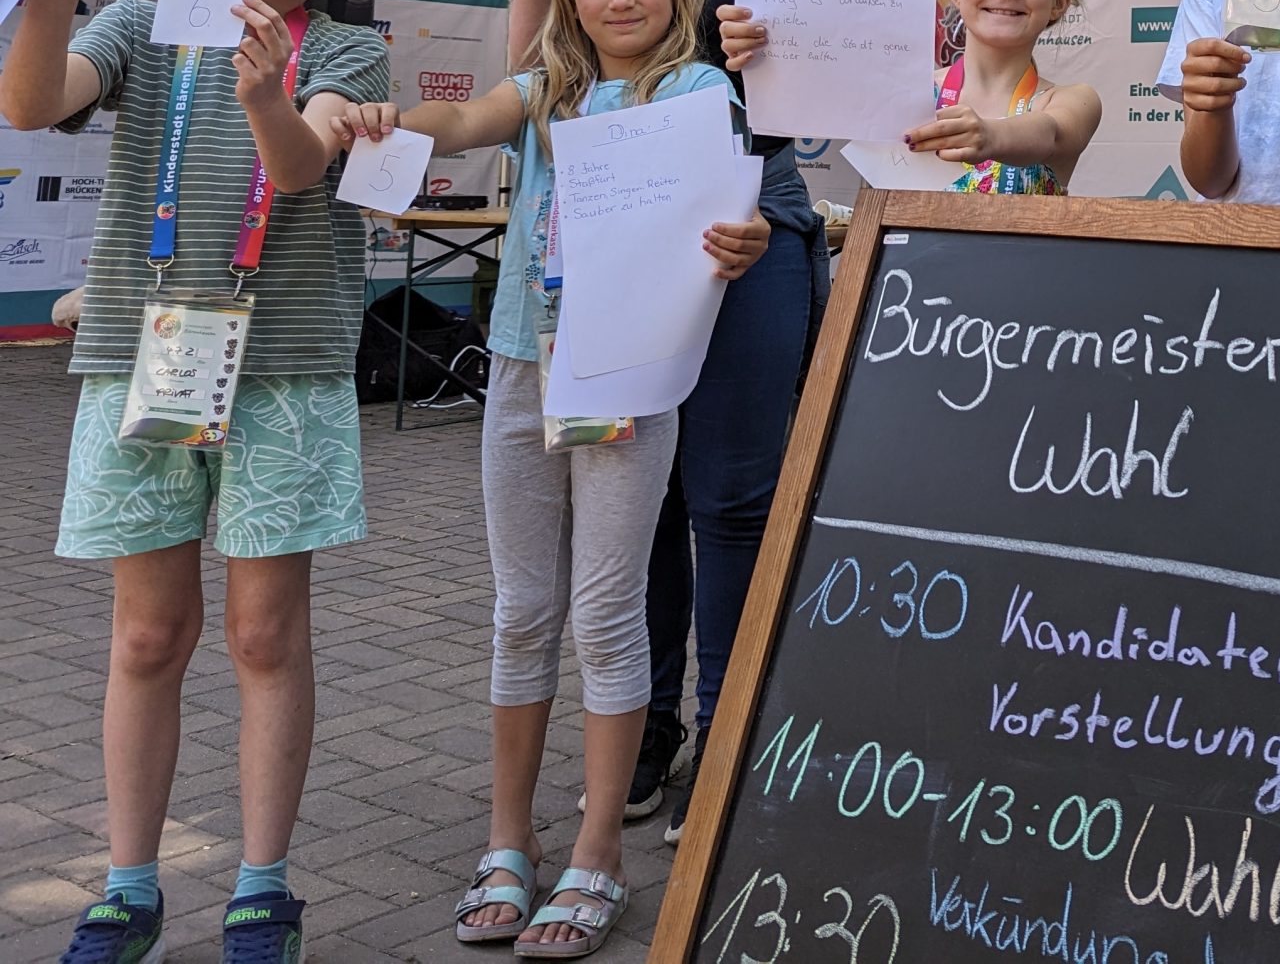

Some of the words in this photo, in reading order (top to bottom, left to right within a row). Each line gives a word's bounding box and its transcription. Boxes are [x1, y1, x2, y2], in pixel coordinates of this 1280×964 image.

[841, 38, 874, 51] Stadt
[420, 72, 473, 88] BLUME
[423, 87, 470, 102] 2000
[1130, 83, 1159, 97] Eine
[1128, 107, 1137, 122] in
[1146, 107, 1170, 122] der
[163, 114, 185, 193] Kinderstadt
[368, 153, 401, 192] 5
[581, 162, 610, 175] Jahre
[568, 173, 616, 189] Staßfurt
[1008, 400, 1194, 500] Wahl
[795, 556, 969, 641] 10:30
